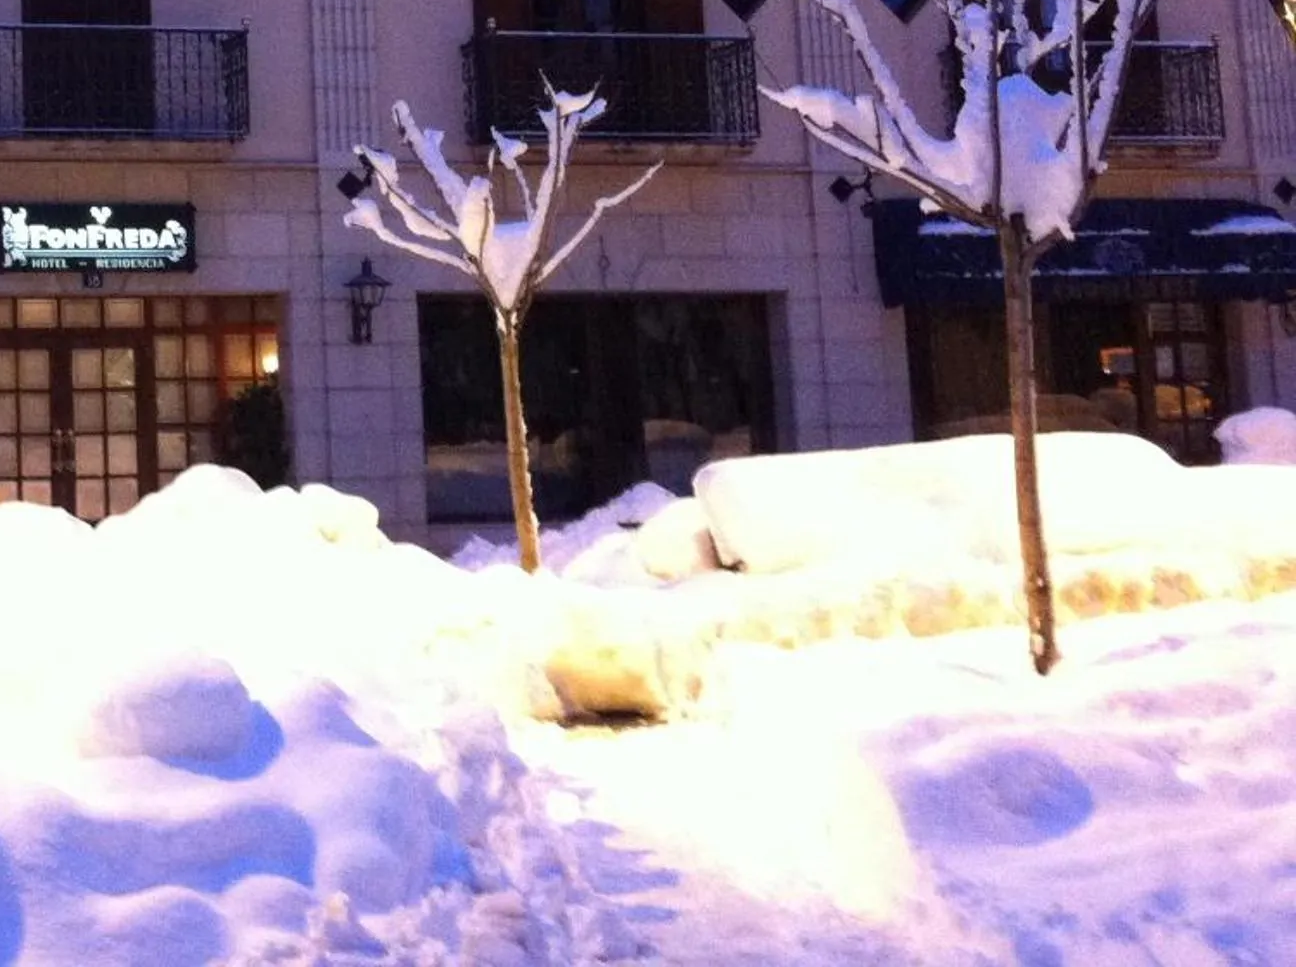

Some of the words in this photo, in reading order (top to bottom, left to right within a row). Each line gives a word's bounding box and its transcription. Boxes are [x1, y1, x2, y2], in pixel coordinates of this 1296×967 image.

[29, 224, 179, 250] FONFREDA
[31, 258, 68, 269] HOTEL
[95, 258, 166, 269] RESIDENCIA
